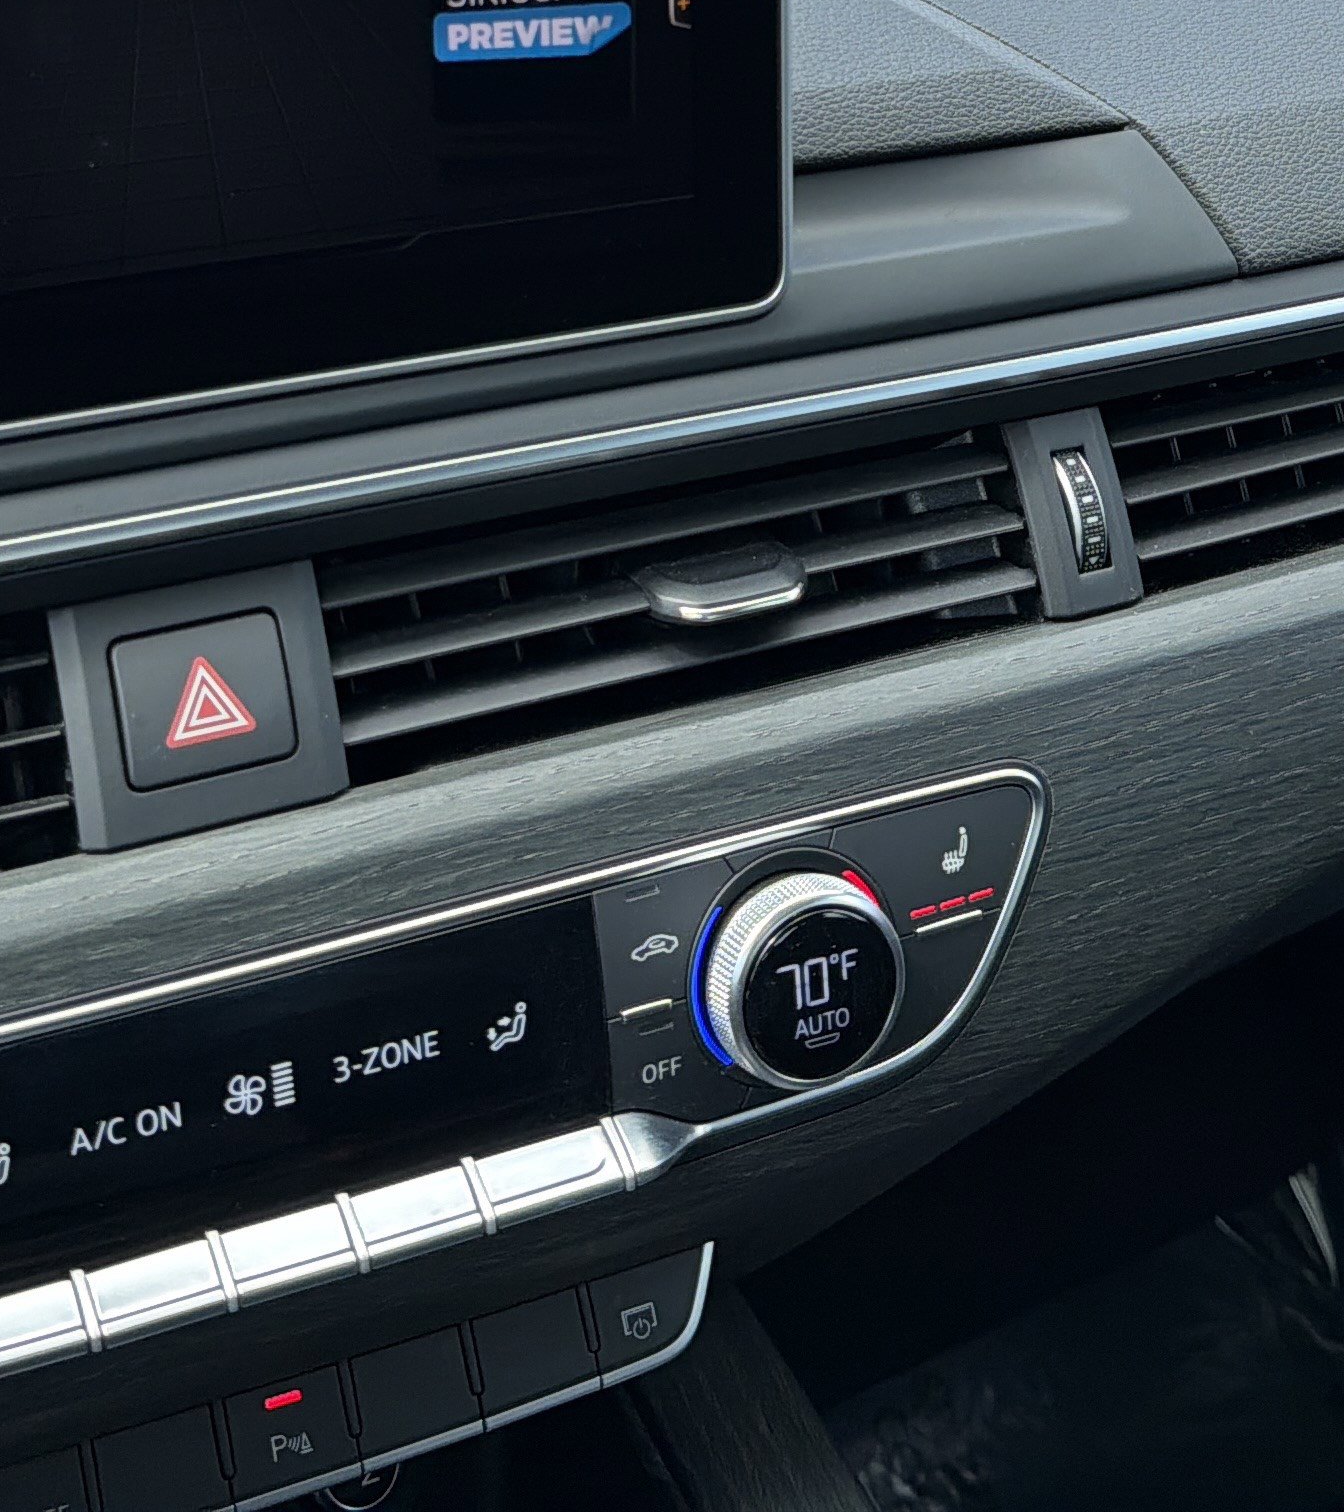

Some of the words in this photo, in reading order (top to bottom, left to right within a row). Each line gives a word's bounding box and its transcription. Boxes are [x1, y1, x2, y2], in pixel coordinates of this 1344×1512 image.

[794, 1007, 851, 1041] AUTO
[332, 1030, 441, 1084] 3-ZONE
[641, 1055, 683, 1085] OFF
[70, 1116, 127, 1156] A/C
[135, 1101, 183, 1137] ON
